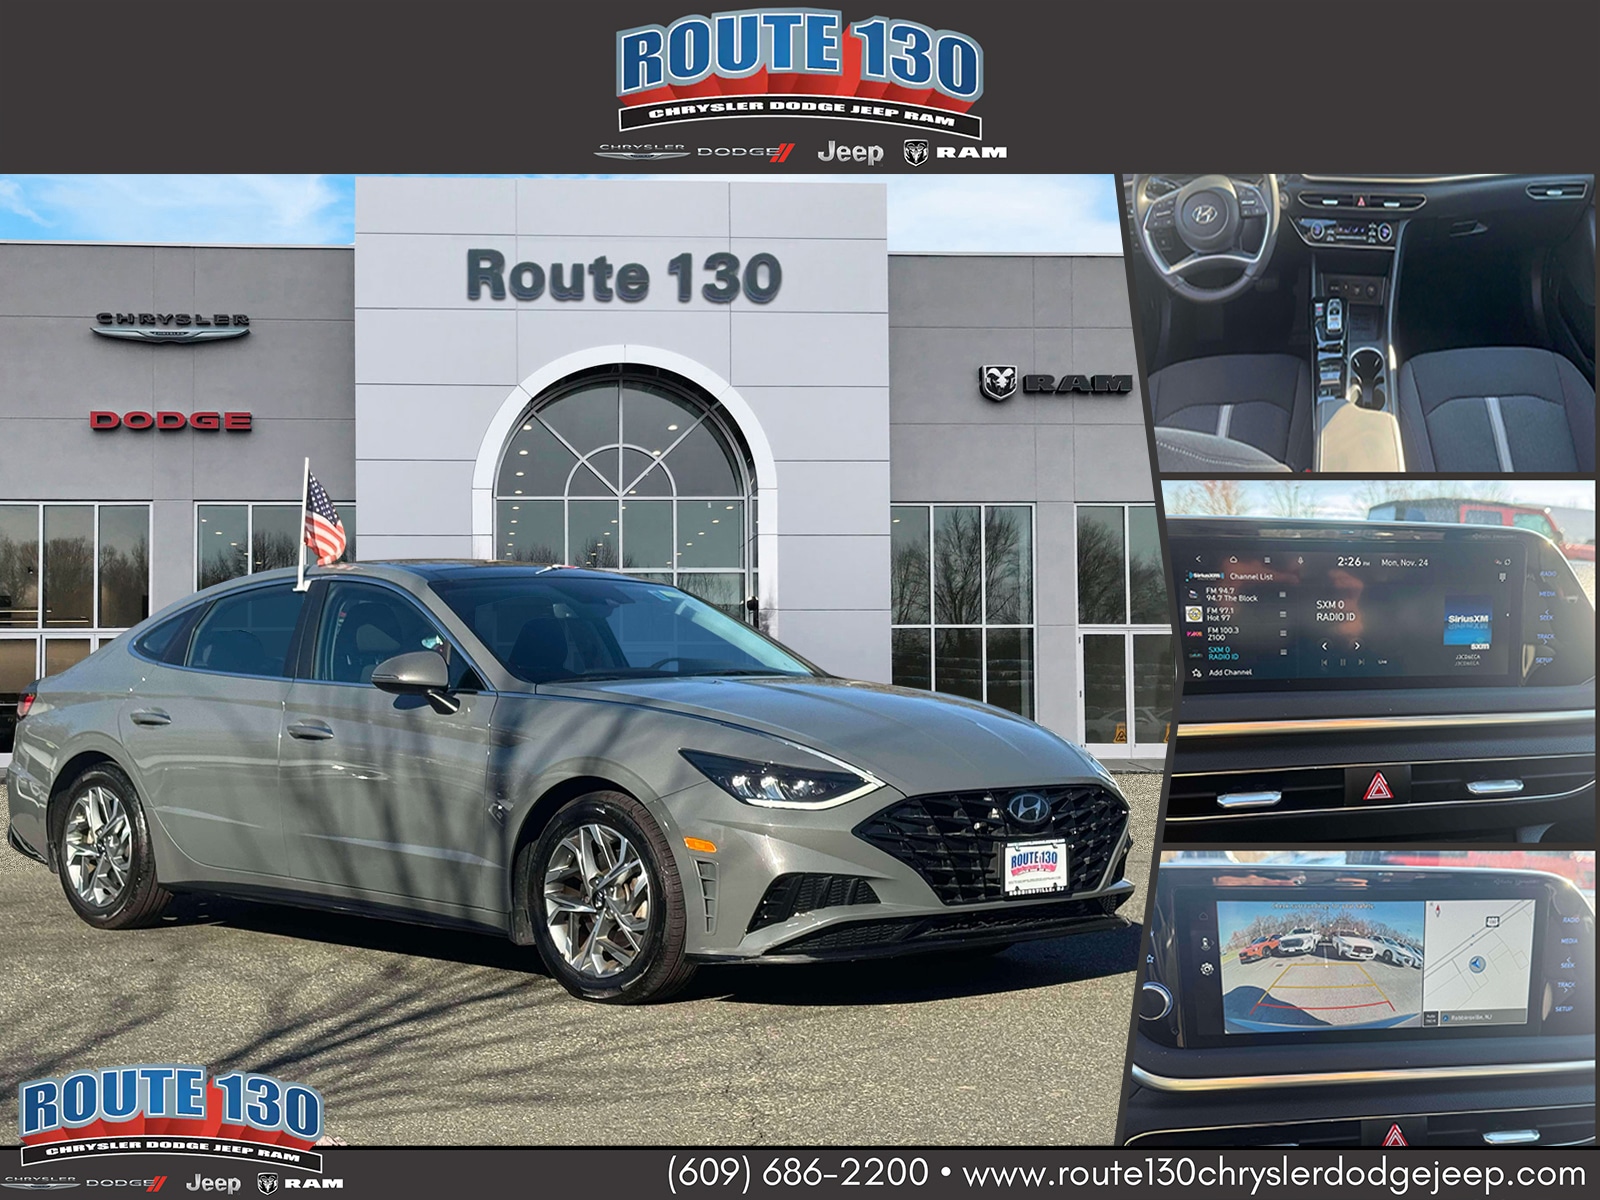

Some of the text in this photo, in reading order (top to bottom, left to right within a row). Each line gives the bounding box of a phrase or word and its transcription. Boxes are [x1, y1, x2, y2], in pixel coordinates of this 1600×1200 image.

[467, 248, 782, 304] Route 130
[96, 313, 250, 326] CHRYSLER
[1022, 374, 1133, 394] RAM
[89, 411, 252, 431] DODGE
[1338, 556, 1361, 567] 2:26
[1381, 559, 1428, 567] Mon, Nov. 24
[1230, 572, 1259, 580] Channel
[1316, 600, 1336, 609] SXM
[1316, 612, 1355, 621] RADIO ID
[1448, 615, 1489, 623] SiriusXM
[1011, 851, 1058, 869] ROUTE 130
